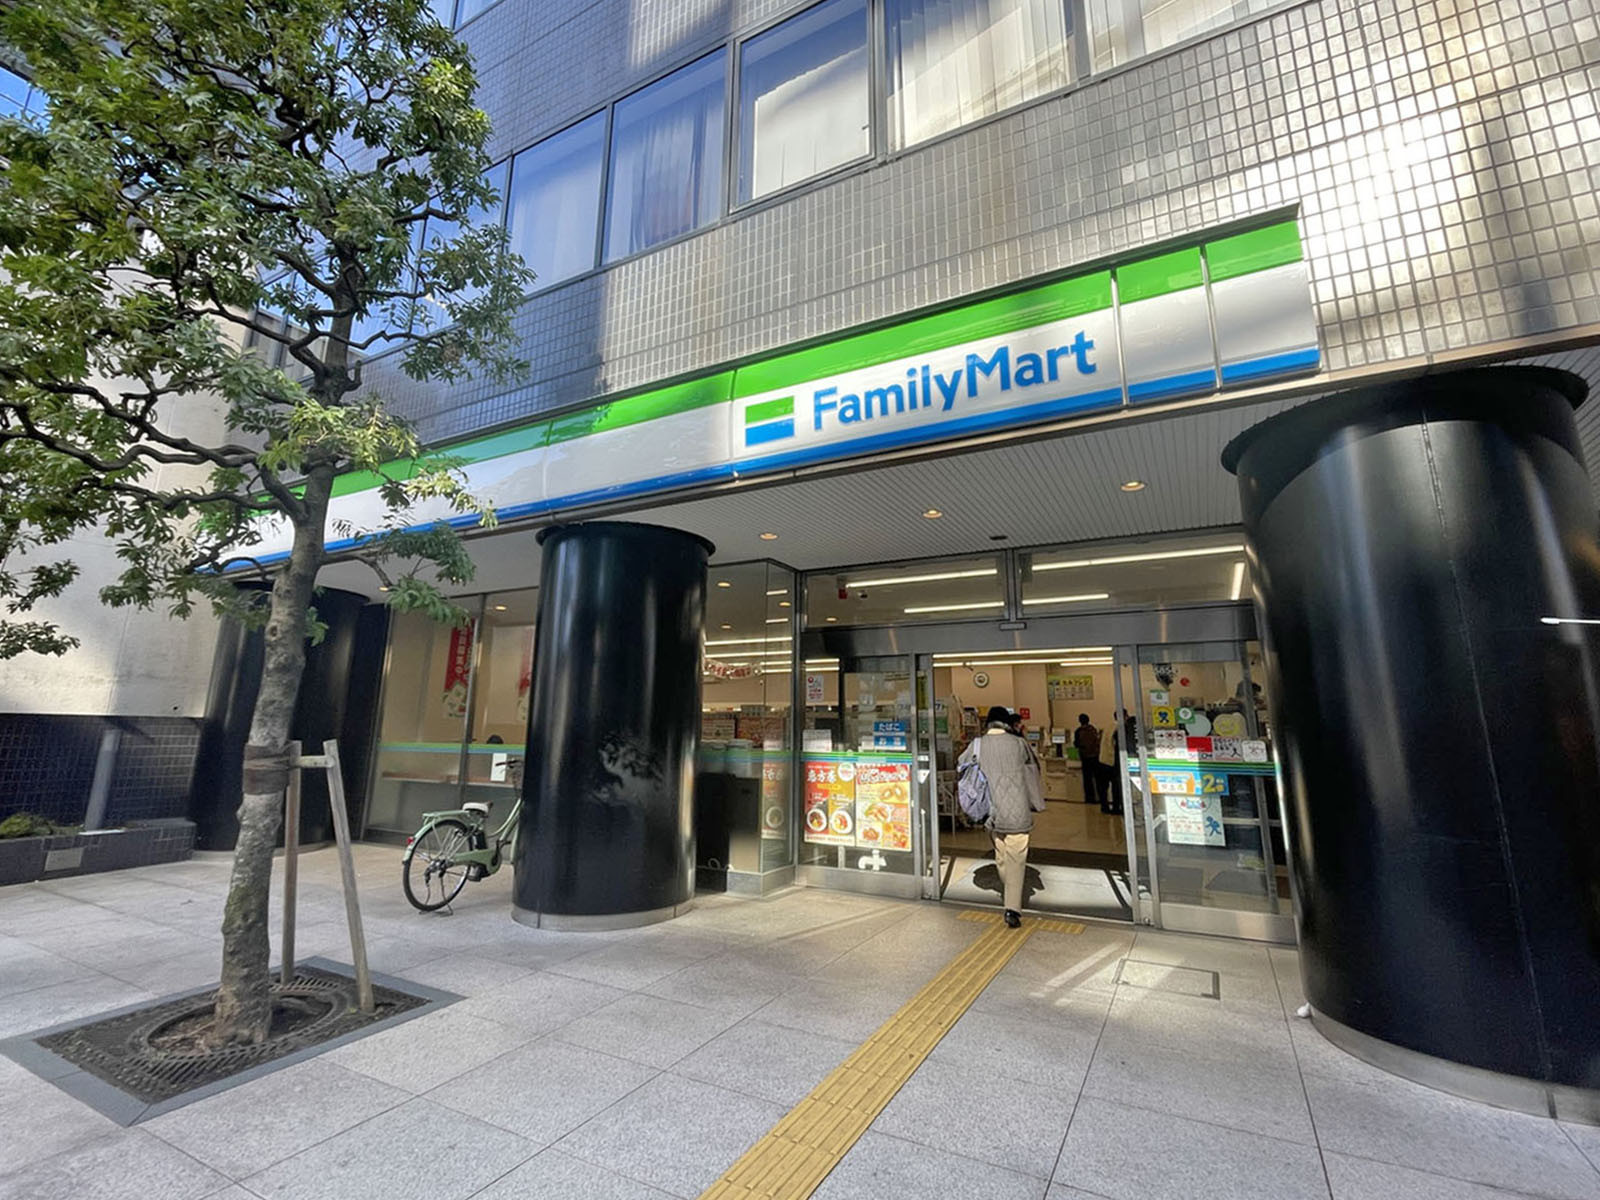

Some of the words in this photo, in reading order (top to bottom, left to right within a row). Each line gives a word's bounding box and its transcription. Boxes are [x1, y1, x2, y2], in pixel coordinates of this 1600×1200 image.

[813, 331, 1097, 431] FamilyMart
[879, 722, 900, 732] たばこ
